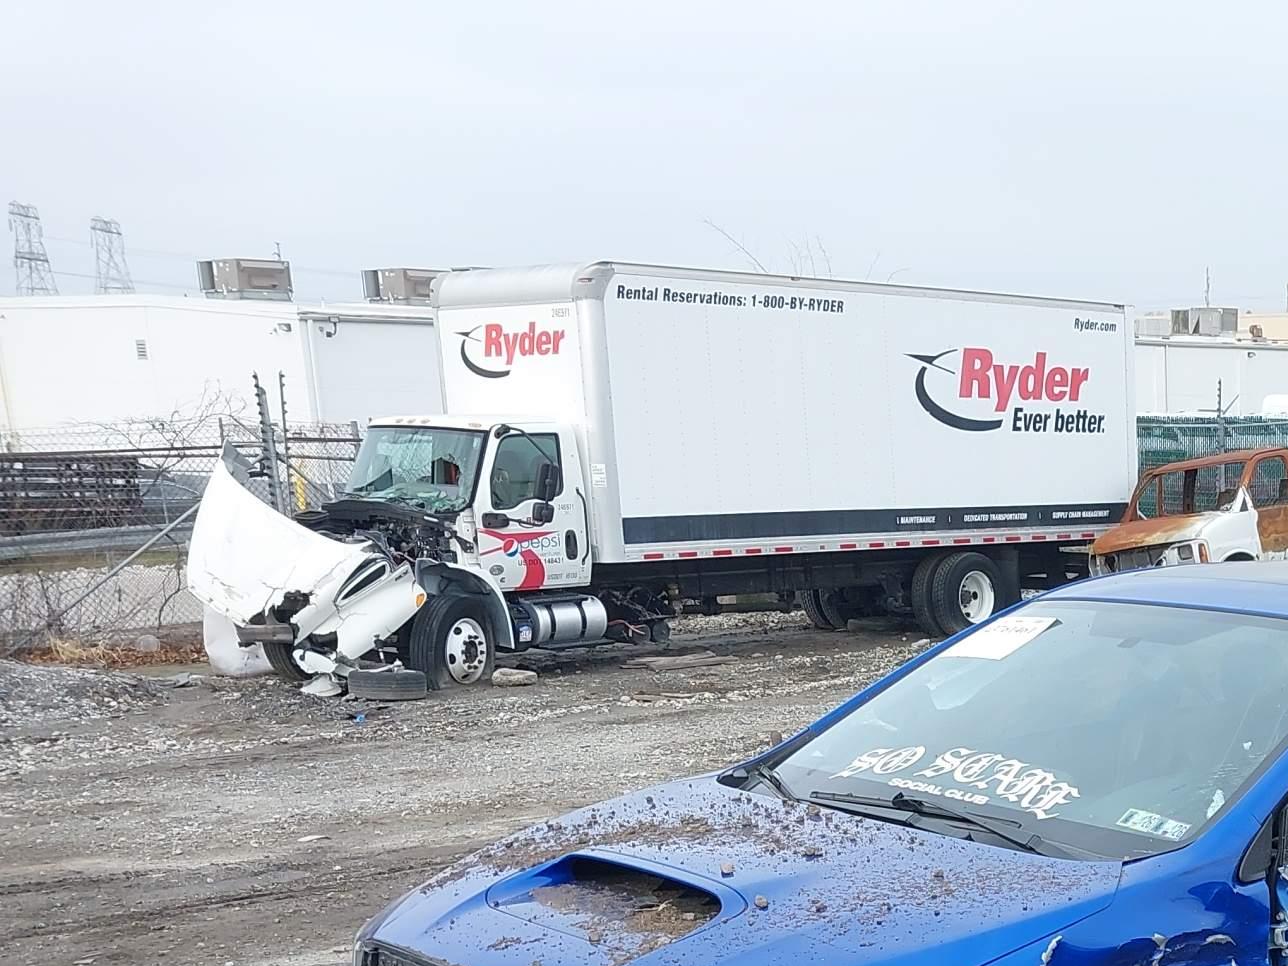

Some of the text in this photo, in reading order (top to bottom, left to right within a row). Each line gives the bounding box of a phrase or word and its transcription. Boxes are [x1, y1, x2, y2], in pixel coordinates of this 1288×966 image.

[616, 285, 845, 313] Rental Reservations: 1-800-BY-RYDER
[1074, 318, 1117, 332] Ryder.com
[484, 321, 565, 365] Ryder
[959, 348, 1089, 412] Ryder
[1012, 407, 1105, 433] Ever better.
[900, 515, 936, 525] MAINTENANCE
[519, 533, 561, 552] pepsi
[829, 746, 926, 779] SO
[888, 778, 990, 805] SOCIAL CLUB
